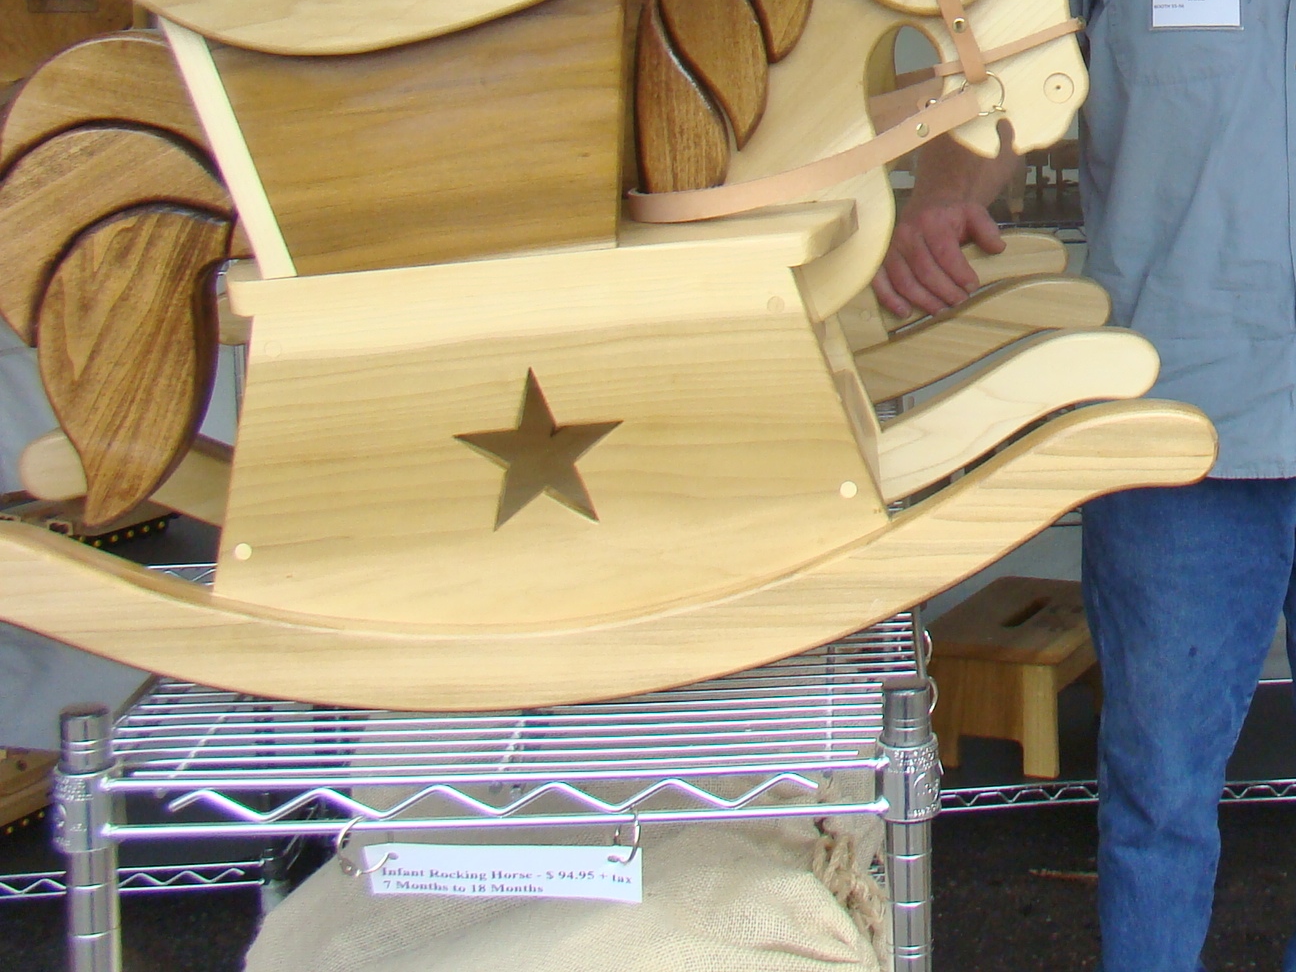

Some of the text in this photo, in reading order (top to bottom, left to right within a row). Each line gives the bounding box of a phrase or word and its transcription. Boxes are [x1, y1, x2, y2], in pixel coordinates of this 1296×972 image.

[382, 867, 425, 878] Infant
[429, 869, 488, 881] Rocking
[491, 870, 533, 880] Horse
[546, 870, 554, 880] $
[558, 870, 595, 880] 94.95
[598, 872, 607, 880] +
[611, 873, 632, 884] tax
[383, 880, 544, 894] 7 Months to 18 Months
